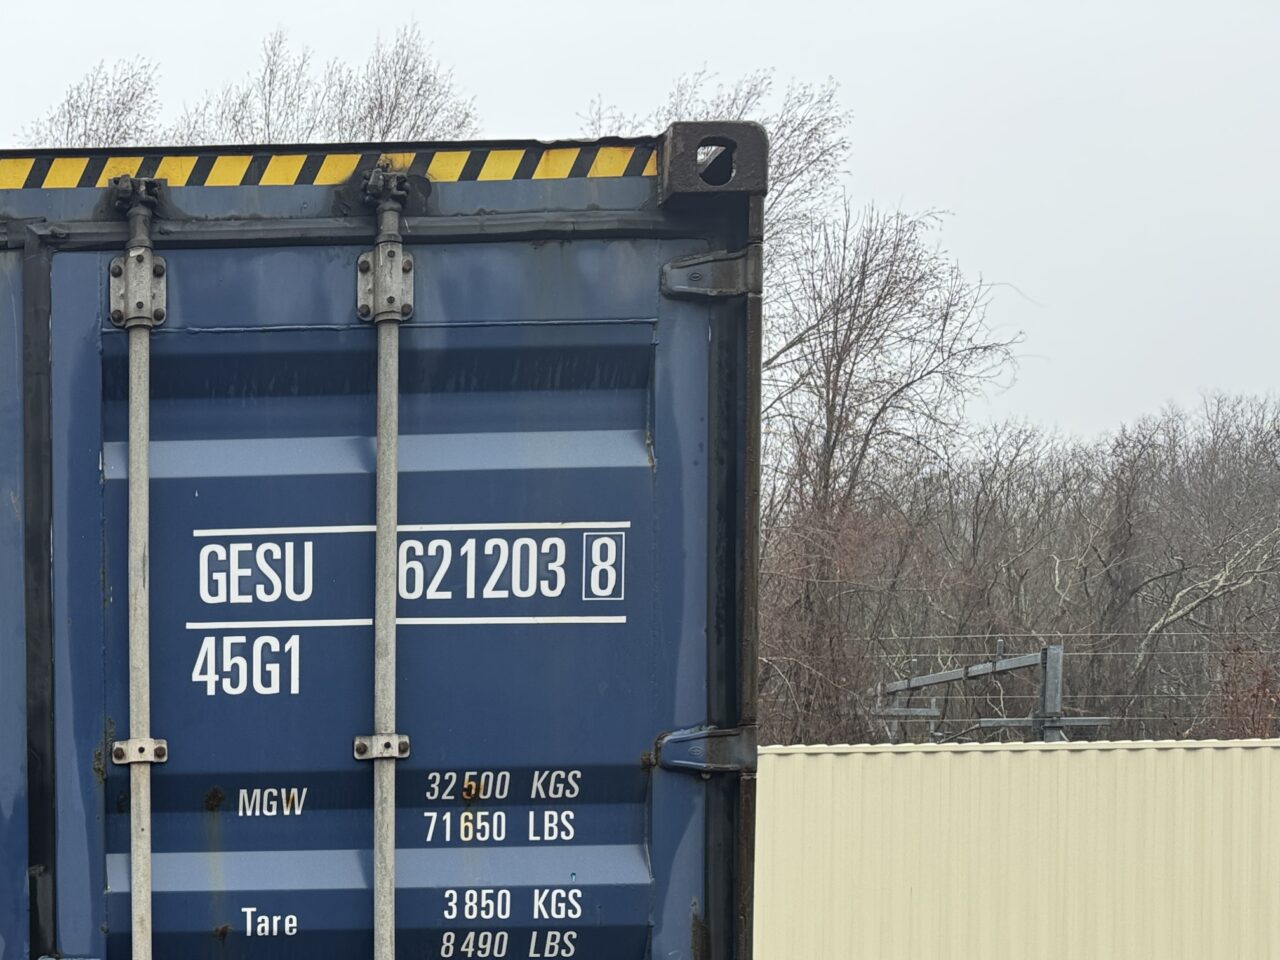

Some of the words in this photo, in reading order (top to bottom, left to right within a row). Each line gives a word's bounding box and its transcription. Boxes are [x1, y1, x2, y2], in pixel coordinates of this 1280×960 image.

[199, 540, 314, 604] GESU
[398, 537, 566, 600] 621203
[590, 536, 617, 597] 8
[191, 634, 300, 696] 45G1
[530, 770, 582, 799] KGS
[238, 787, 308, 817] MGW
[528, 810, 575, 841] LBS
[533, 888, 582, 919] KGS
[241, 907, 298, 937] Tare
[528, 930, 577, 958] LBS
